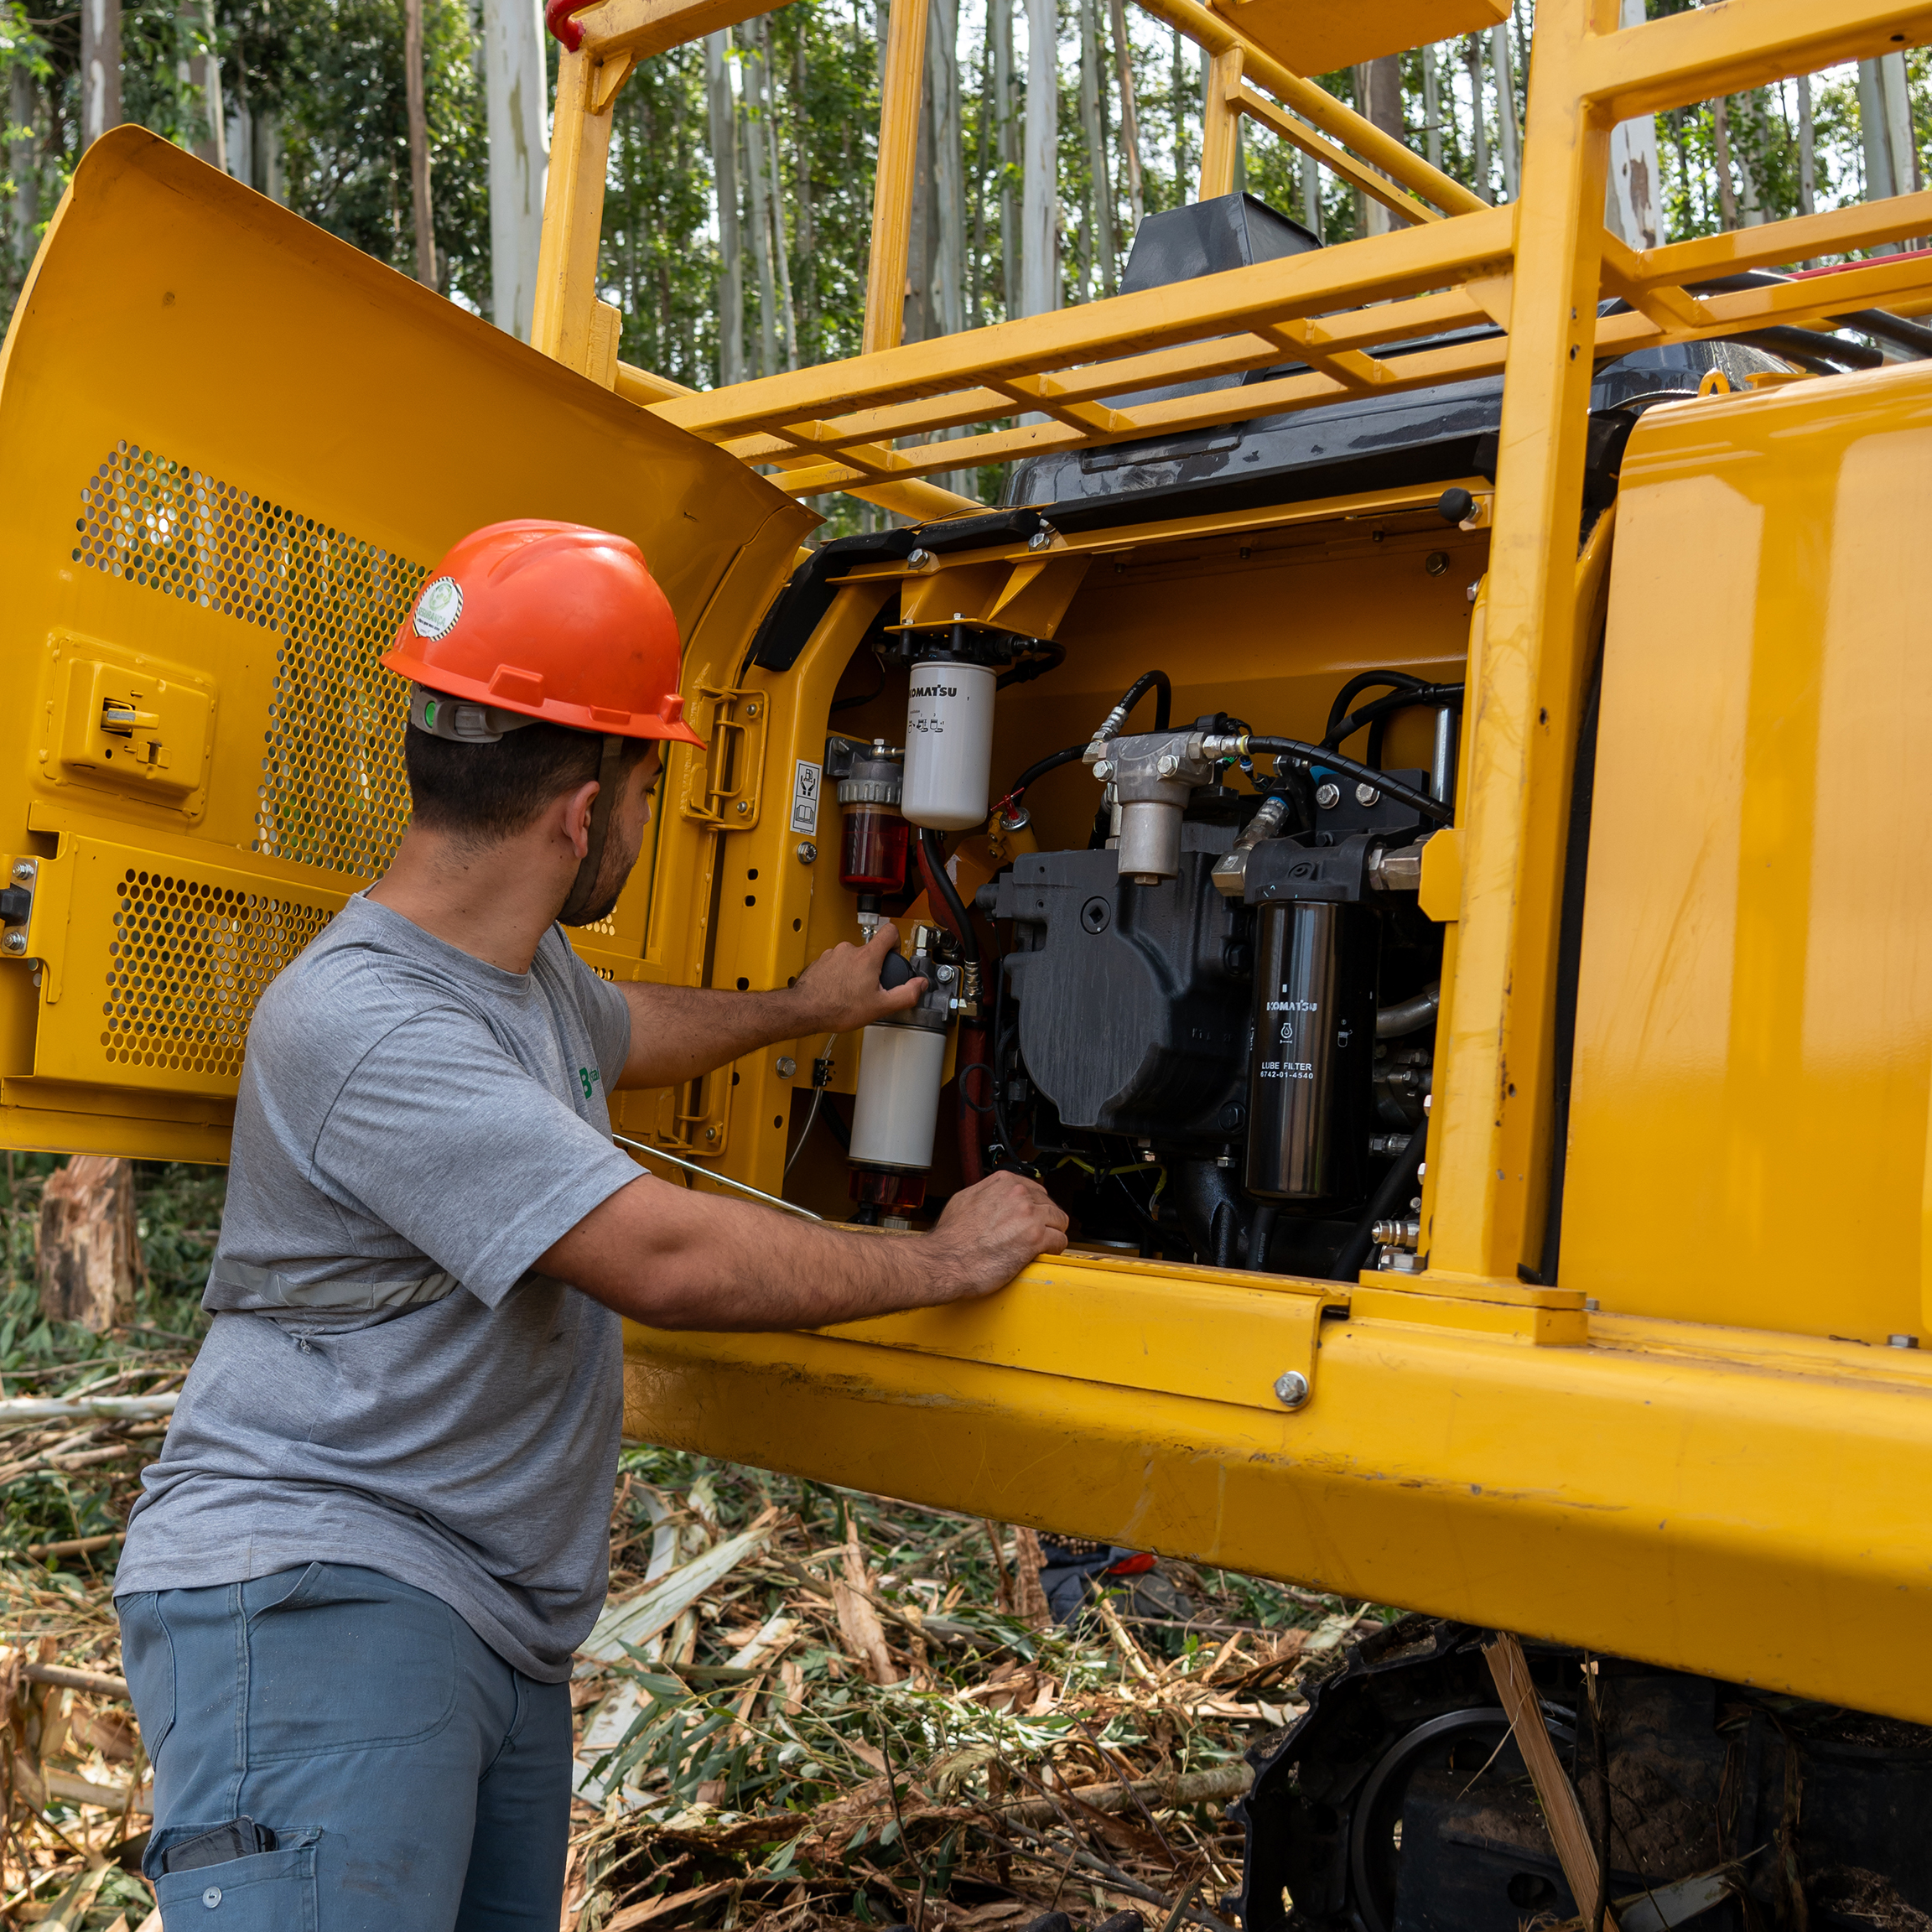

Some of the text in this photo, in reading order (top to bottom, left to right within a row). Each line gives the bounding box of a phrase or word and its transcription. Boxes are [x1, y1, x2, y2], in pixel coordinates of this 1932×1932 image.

[1266, 999, 1317, 1011] KOMATSU
[1261, 1062, 1312, 1072] LUBE FILTER
[1259, 1070, 1314, 1080] 6742-01-4540
